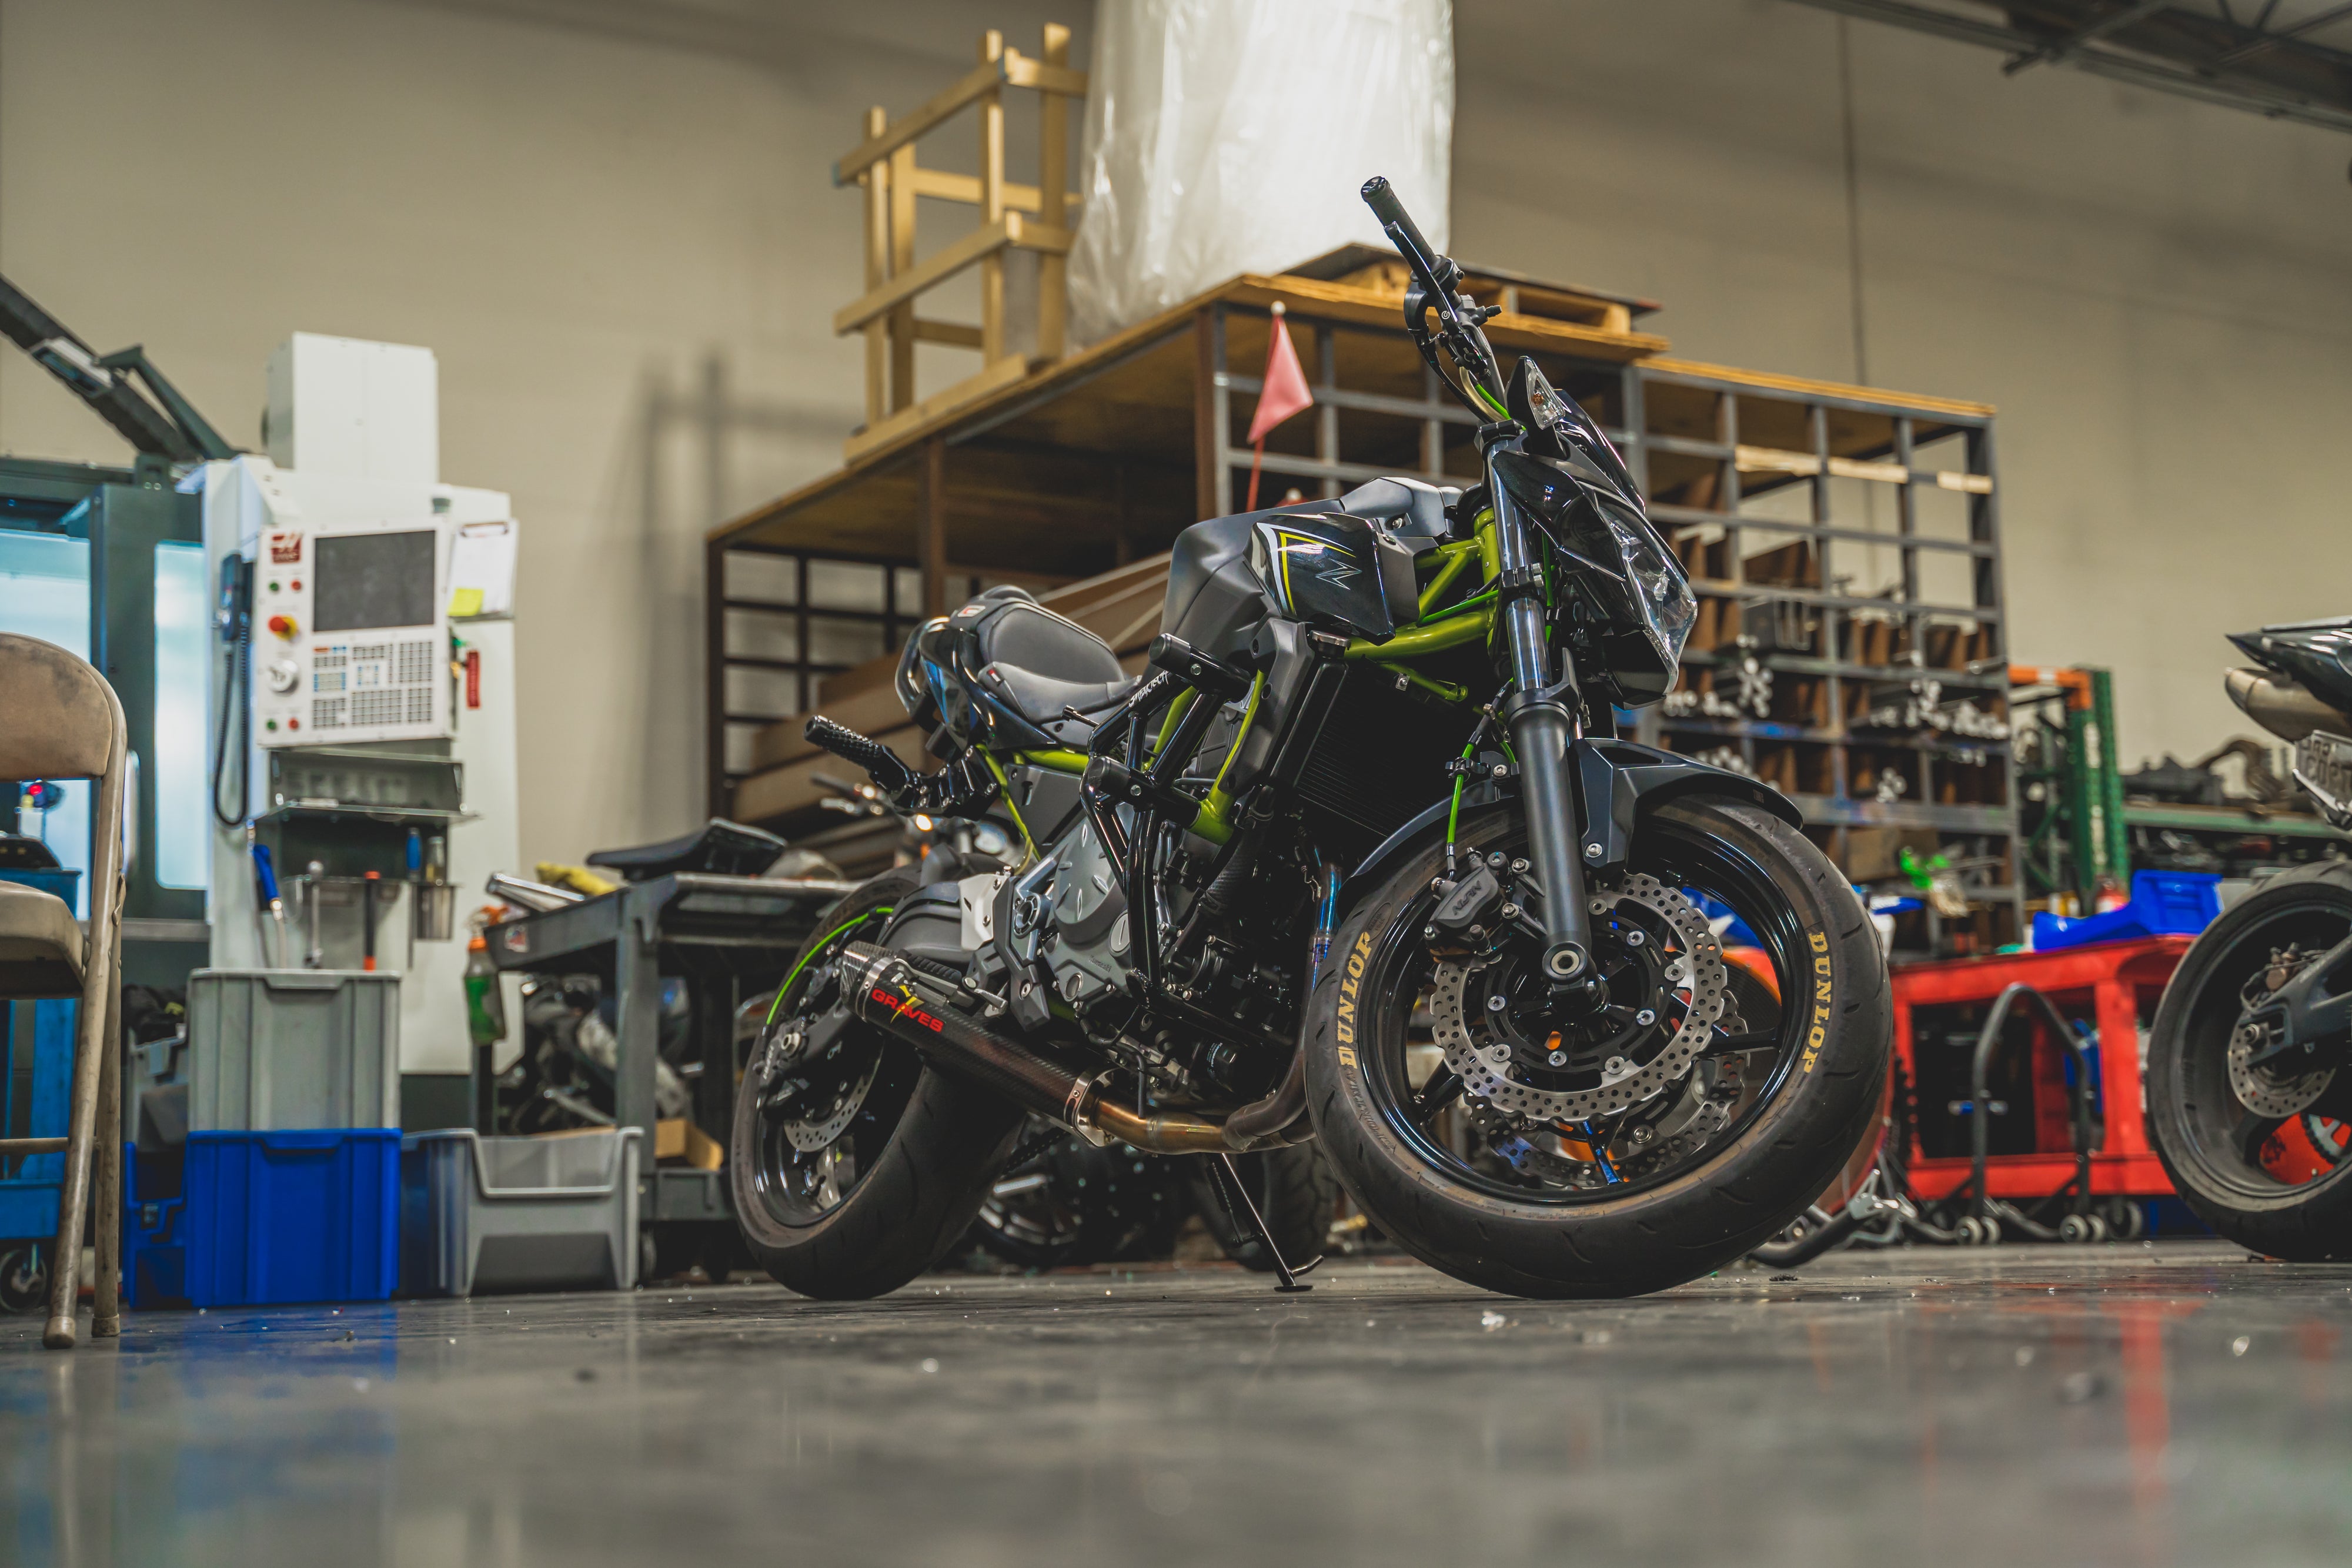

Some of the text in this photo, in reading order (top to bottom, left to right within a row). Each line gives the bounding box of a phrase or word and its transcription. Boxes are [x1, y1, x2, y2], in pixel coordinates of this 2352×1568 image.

[871, 988, 944, 1033] GRAVES
[1337, 931, 1372, 1069] DUNLOP
[1802, 931, 1832, 1073] DUNLOP
